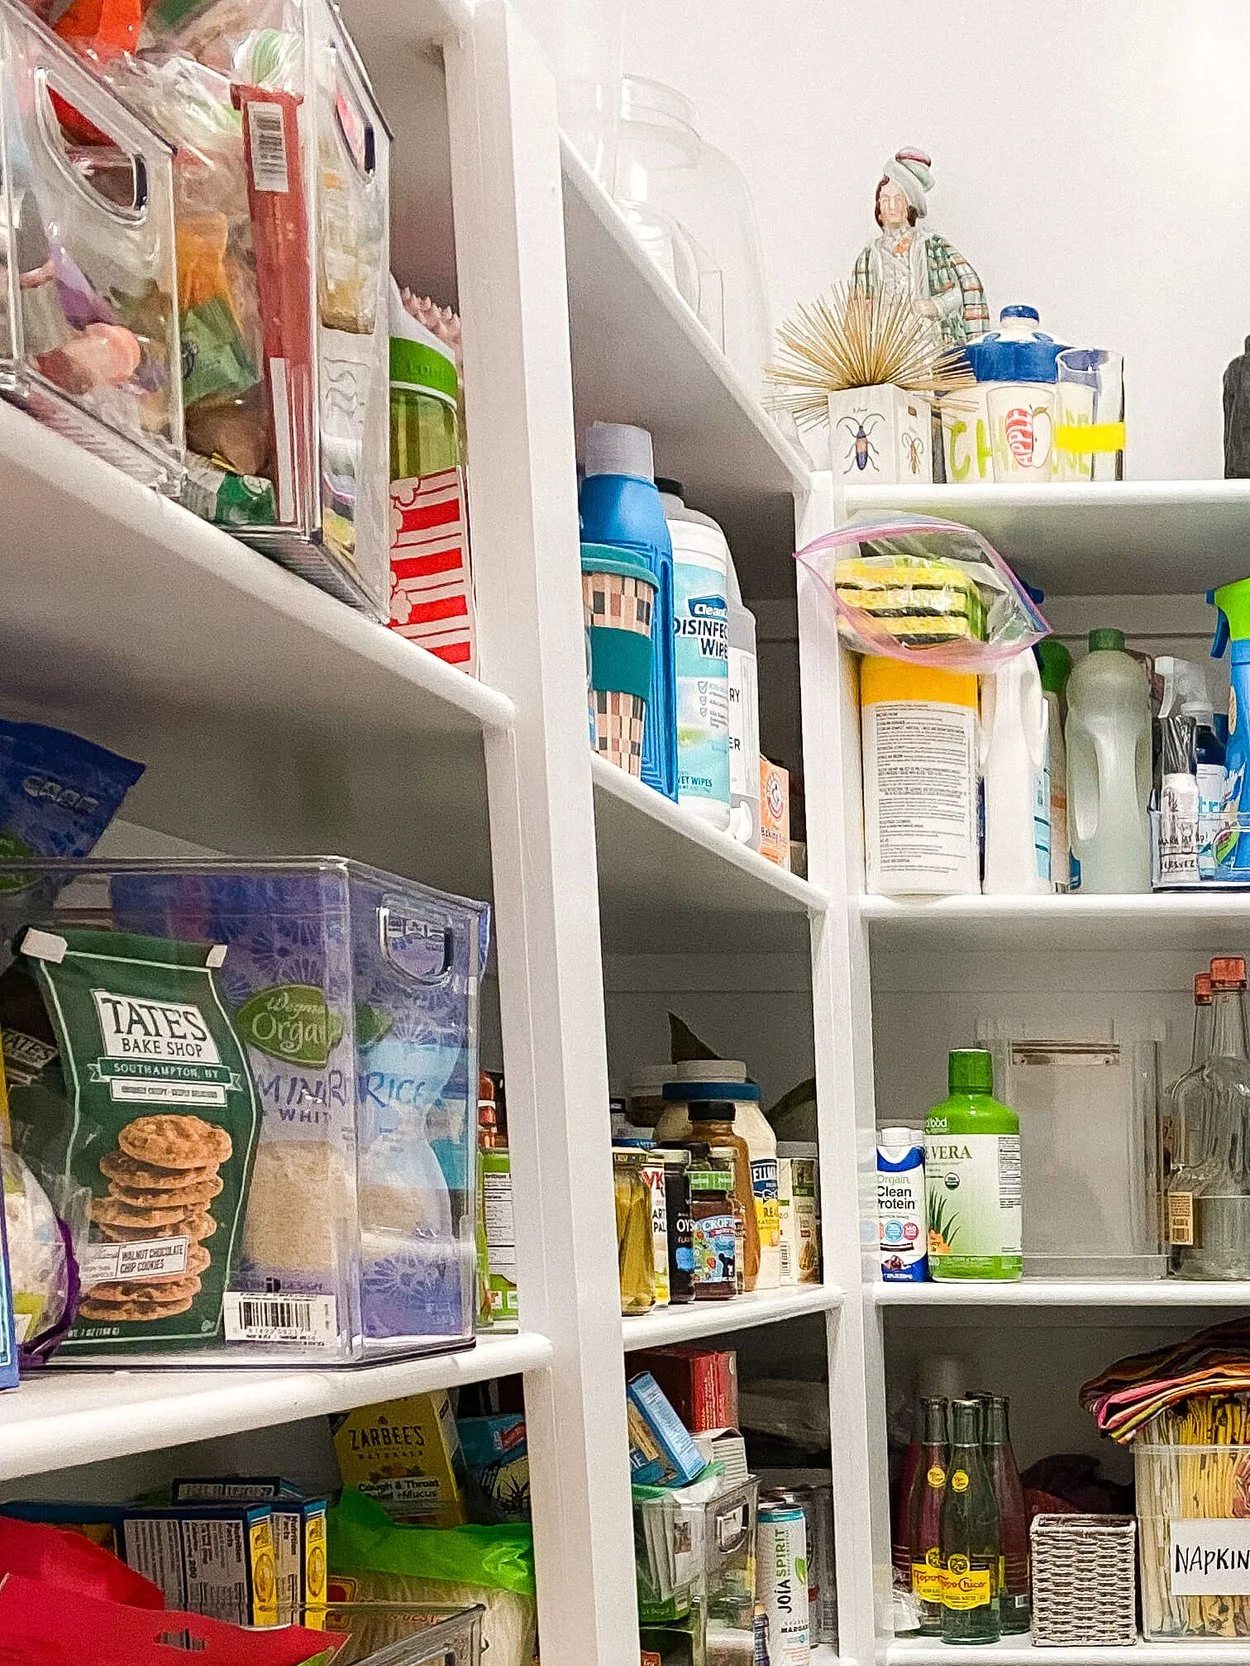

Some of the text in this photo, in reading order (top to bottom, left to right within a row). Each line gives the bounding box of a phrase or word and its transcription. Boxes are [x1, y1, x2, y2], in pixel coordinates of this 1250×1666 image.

[122, 1037, 203, 1058] BAKE SHOP
[931, 1145, 972, 1160] VERA
[121, 1244, 183, 1261] WALNUT CHOCOLATE
[120, 1262, 136, 1273] CHIP
[350, 1425, 425, 1450] ZARBEE'S
[358, 1479, 393, 1492] Cough
[404, 1479, 439, 1488] Throat
[774, 1528, 787, 1578] SPIRIT
[958, 1576, 987, 1592] Chico
